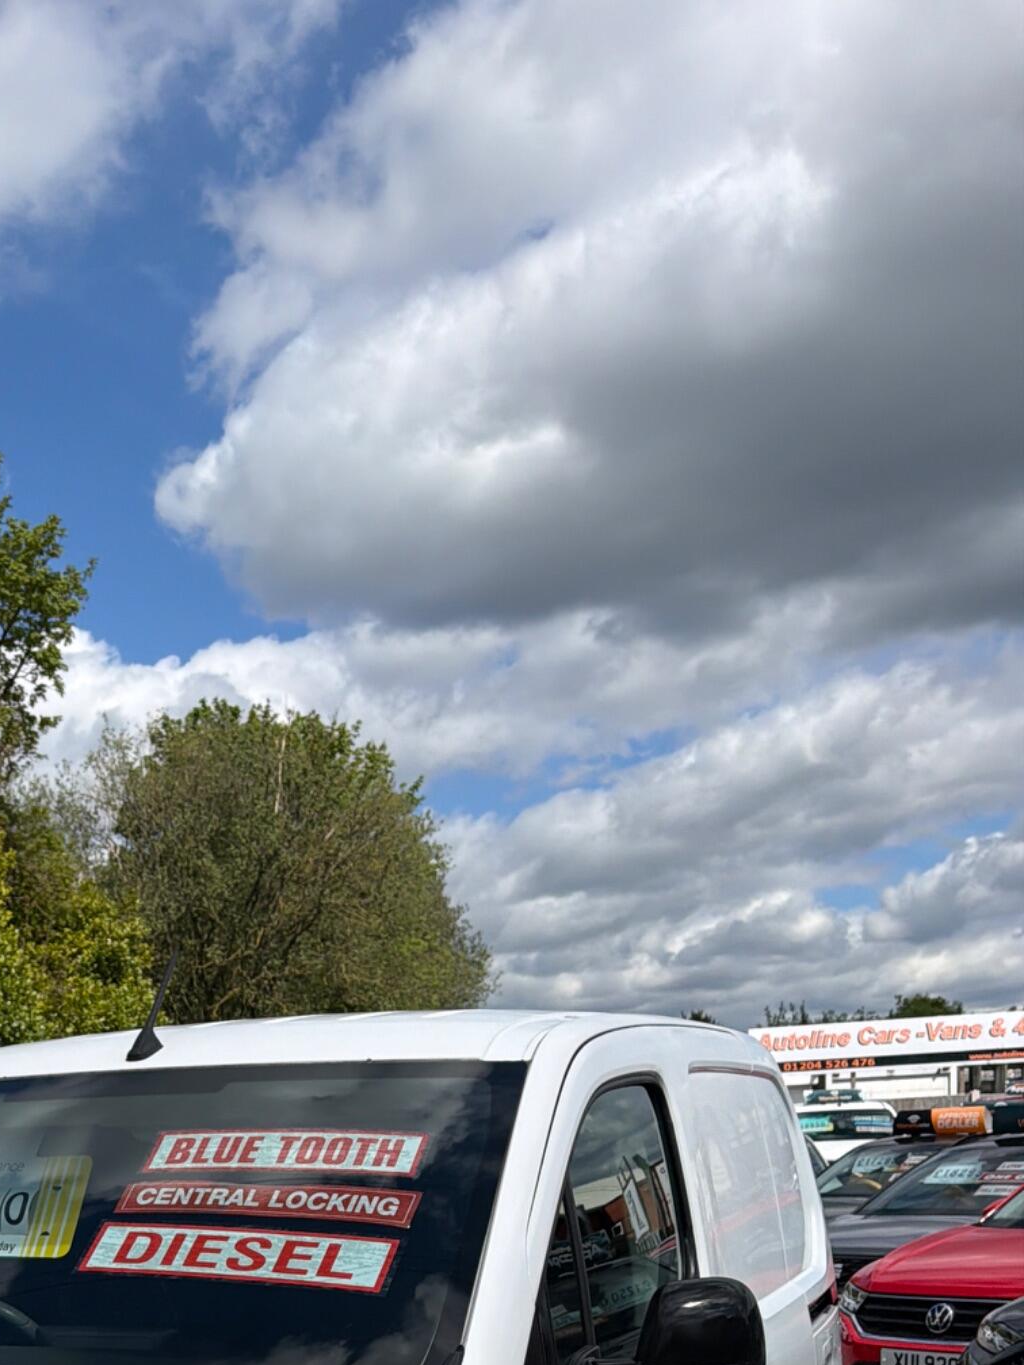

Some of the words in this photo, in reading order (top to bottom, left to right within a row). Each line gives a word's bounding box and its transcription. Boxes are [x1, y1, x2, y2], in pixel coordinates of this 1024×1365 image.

[759, 1029, 852, 1051] Autoline
[857, 1026, 910, 1045] Cars
[989, 1018, 1007, 1037] &
[783, 1061, 822, 1071] 01204
[826, 1059, 848, 1069] 526
[851, 1057, 876, 1067] 476
[937, 1118, 979, 1128] DEALER
[165, 1135, 265, 1165] BLUE
[276, 1135, 406, 1168] TOOTH
[135, 1187, 261, 1208] CENTRAL
[267, 1190, 401, 1217] LOCKING
[112, 1231, 354, 1280] DIESEL
